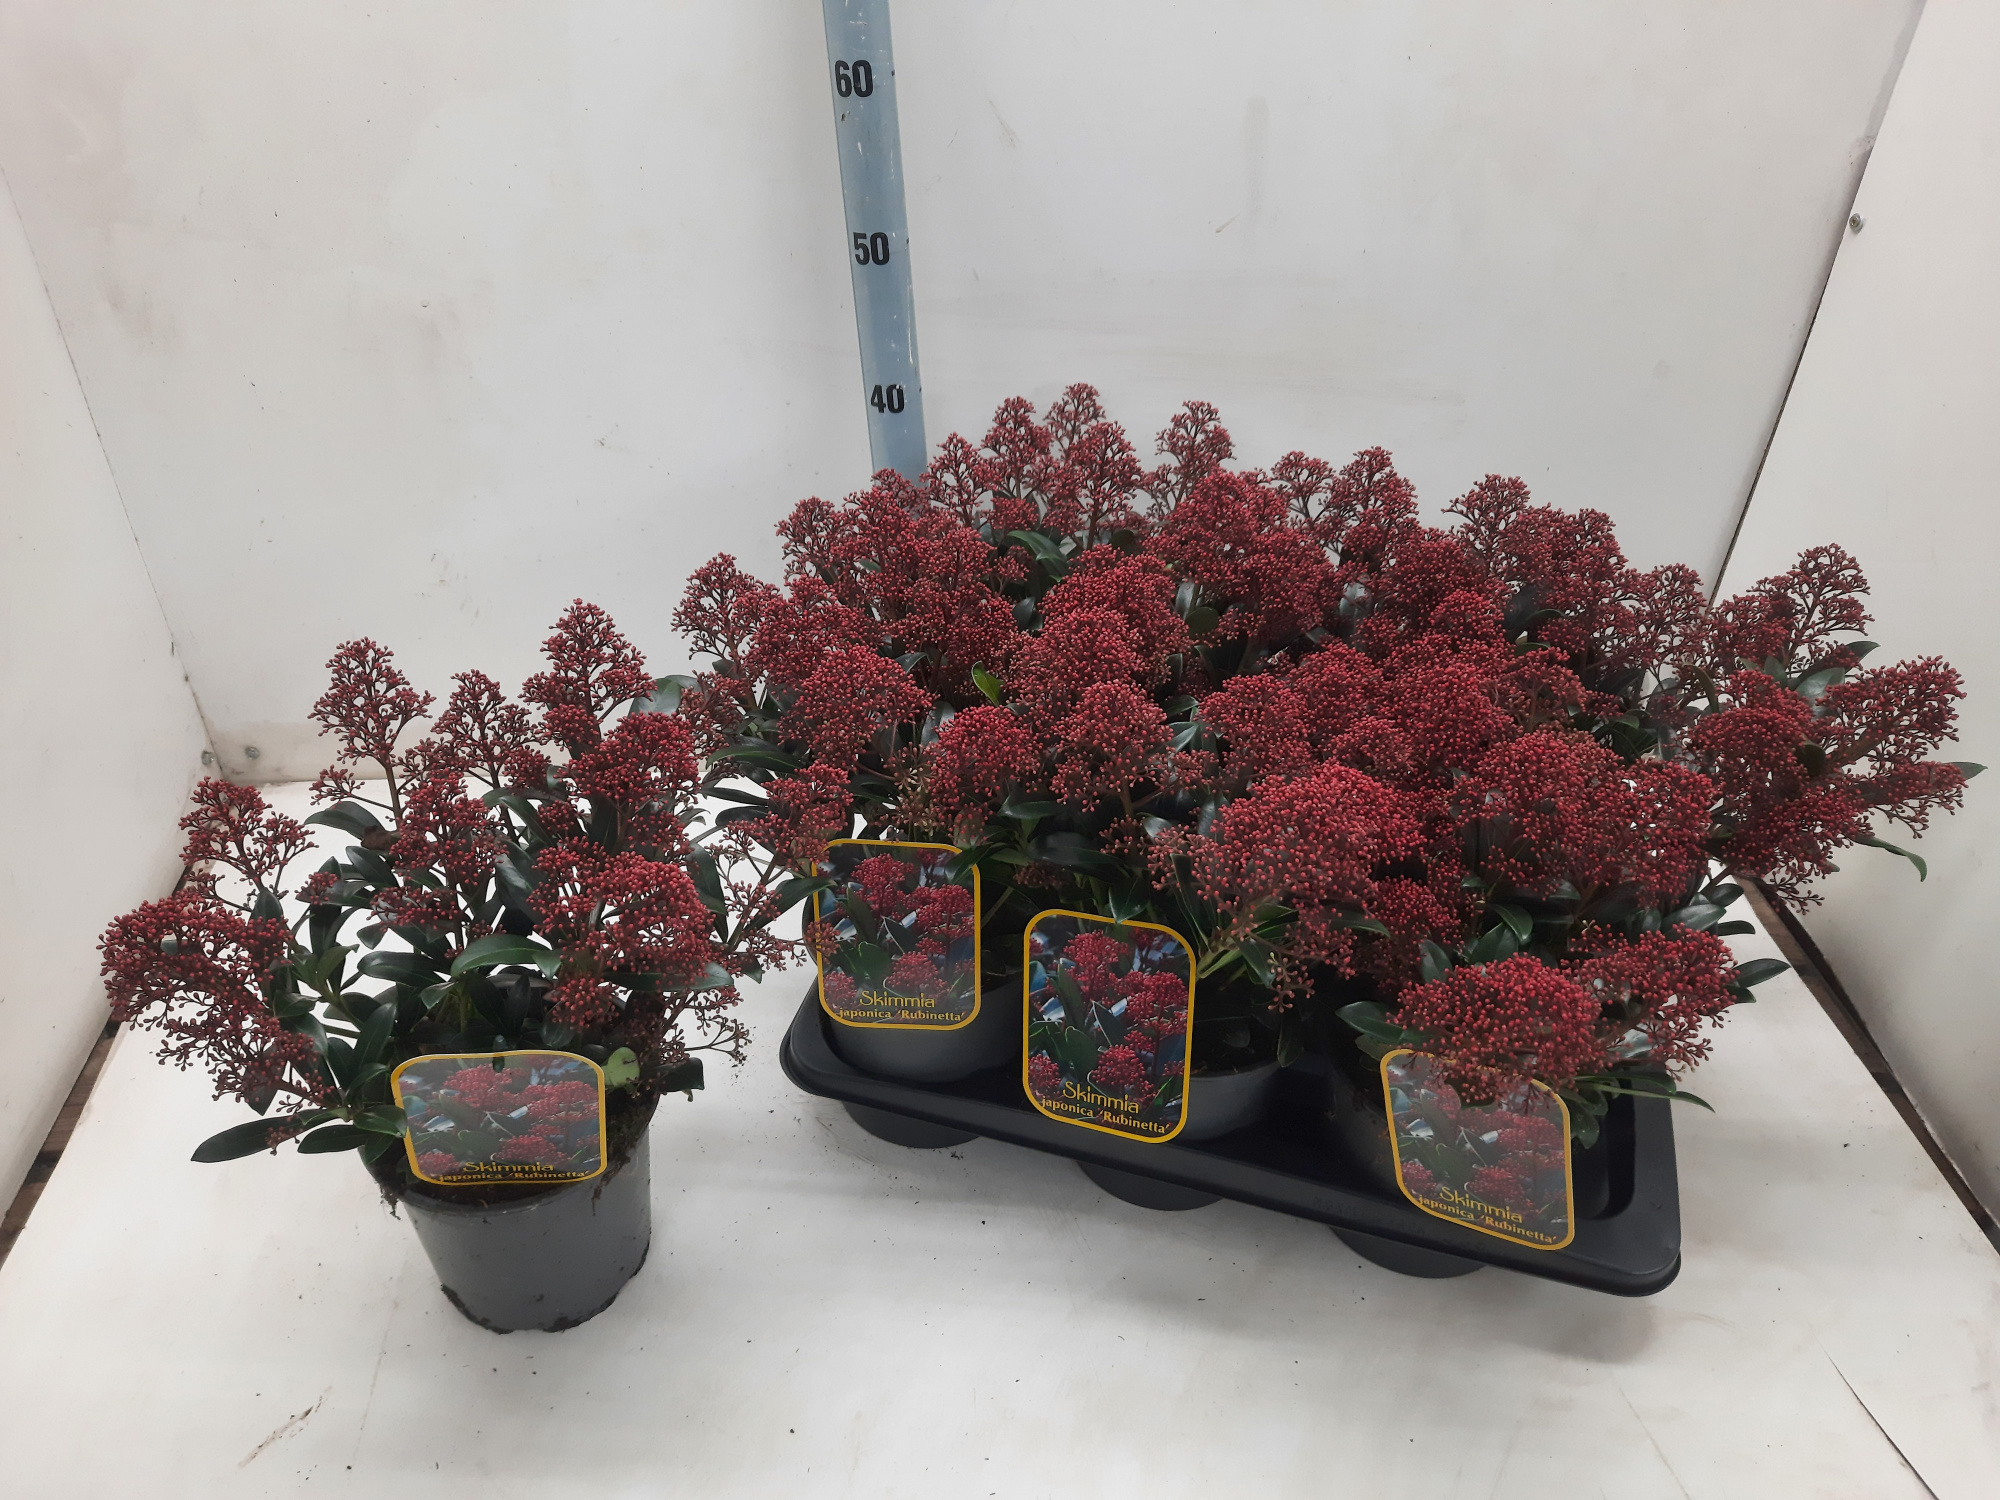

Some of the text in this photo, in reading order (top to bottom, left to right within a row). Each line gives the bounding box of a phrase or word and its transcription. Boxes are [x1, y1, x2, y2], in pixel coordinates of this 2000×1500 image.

[835, 60, 873, 97] 60
[853, 232, 890, 265] 50
[870, 384, 905, 414] 40
[860, 990, 935, 1008] Skimmia
[839, 1008, 892, 1018] japonica
[1041, 1096, 1094, 1117] japonica
[1062, 1081, 1139, 1114] Skimmia
[439, 1173, 502, 1182] japonica
[462, 1161, 554, 1172] Skimmia
[1418, 1195, 1475, 1220] japonica
[1440, 1186, 1523, 1223] Skimmia
